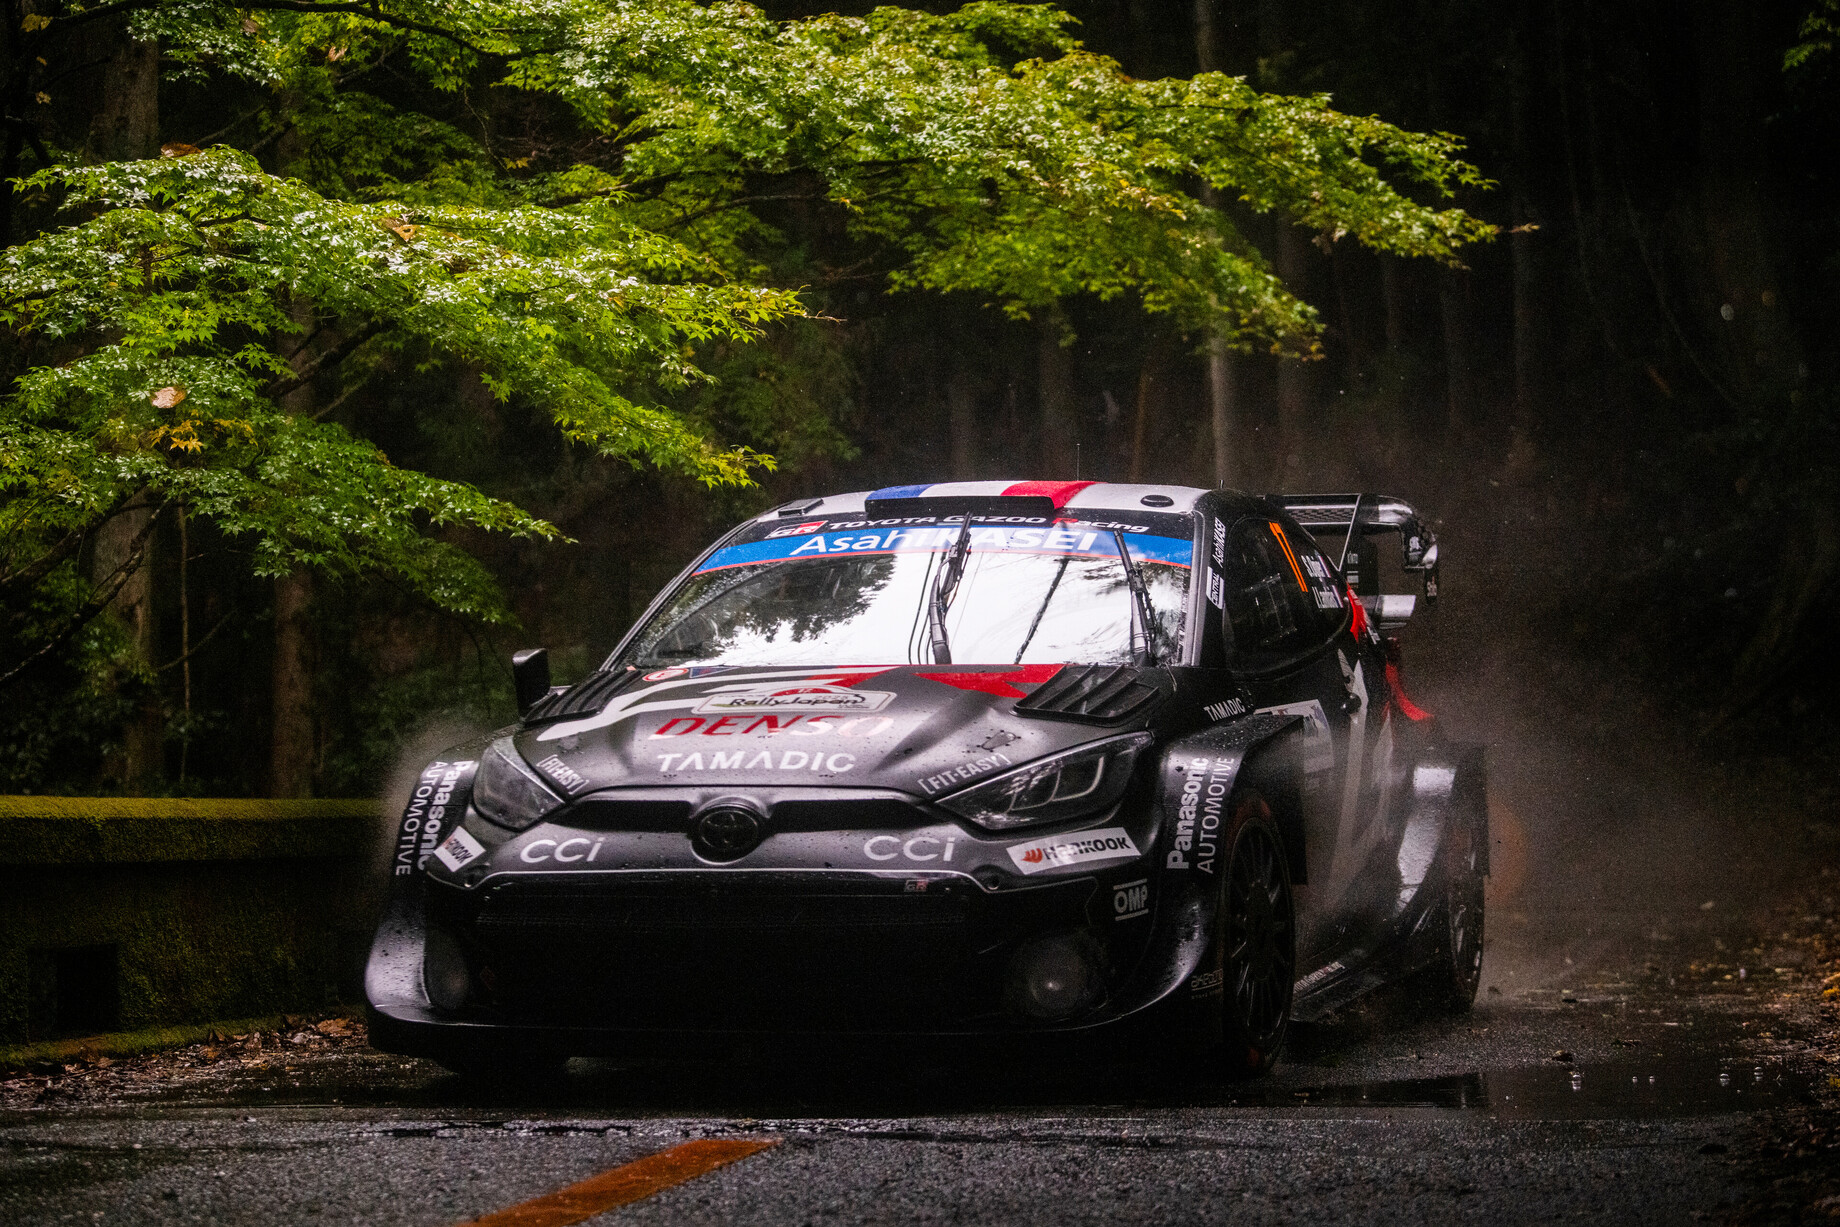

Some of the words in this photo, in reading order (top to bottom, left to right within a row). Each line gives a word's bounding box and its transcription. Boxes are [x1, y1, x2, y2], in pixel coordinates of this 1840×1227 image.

[828, 516, 937, 530] TOYOTA
[943, 515, 1047, 524] GAZOO
[1052, 517, 1150, 533] Racing
[1203, 697, 1246, 722] TAMADIC
[648, 714, 894, 740] DENSO
[657, 751, 856, 773] TAMADIC
[395, 761, 449, 876] AUTOMOTIVE
[417, 760, 475, 871] Panasonic
[1166, 756, 1210, 870] Panasonic
[1197, 756, 1236, 875] AUTOMOTIVE
[1113, 884, 1149, 914] OMP
